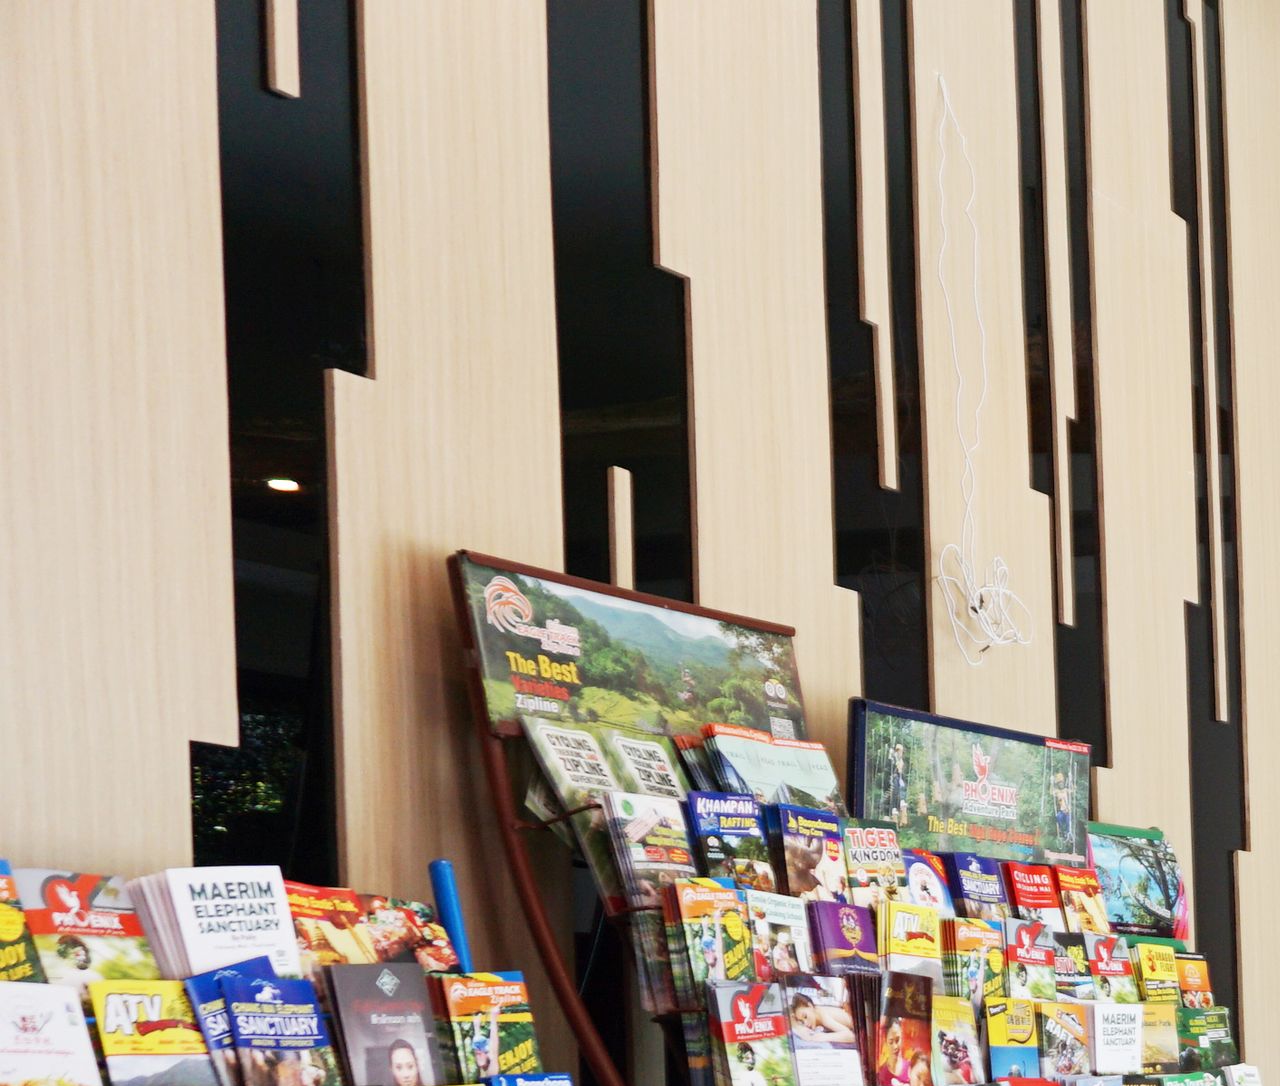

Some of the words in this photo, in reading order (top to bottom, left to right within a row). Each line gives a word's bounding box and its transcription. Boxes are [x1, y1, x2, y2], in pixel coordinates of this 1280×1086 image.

[505, 650, 536, 676] The
[537, 654, 582, 685] Best
[515, 694, 559, 712] Zipline
[559, 757, 608, 777] ZIPLINE
[638, 769, 677, 788] ZIPLINE
[963, 780, 1018, 806] PHOENIX
[696, 797, 754, 814] KHAMPAN
[719, 816, 757, 830] RAFTING
[928, 815, 945, 833] The
[946, 818, 967, 836] Best
[847, 828, 898, 849] TIGER
[850, 848, 902, 864] KINGDOM
[189, 881, 274, 902] MAERIM
[194, 902, 277, 919] ELEPHANT
[198, 918, 280, 935] SANCTUARY
[893, 910, 920, 938] ATV
[105, 992, 162, 1036] ATV
[1102, 1013, 1136, 1025] MAERIM
[236, 1016, 320, 1036] SANCTUARY
